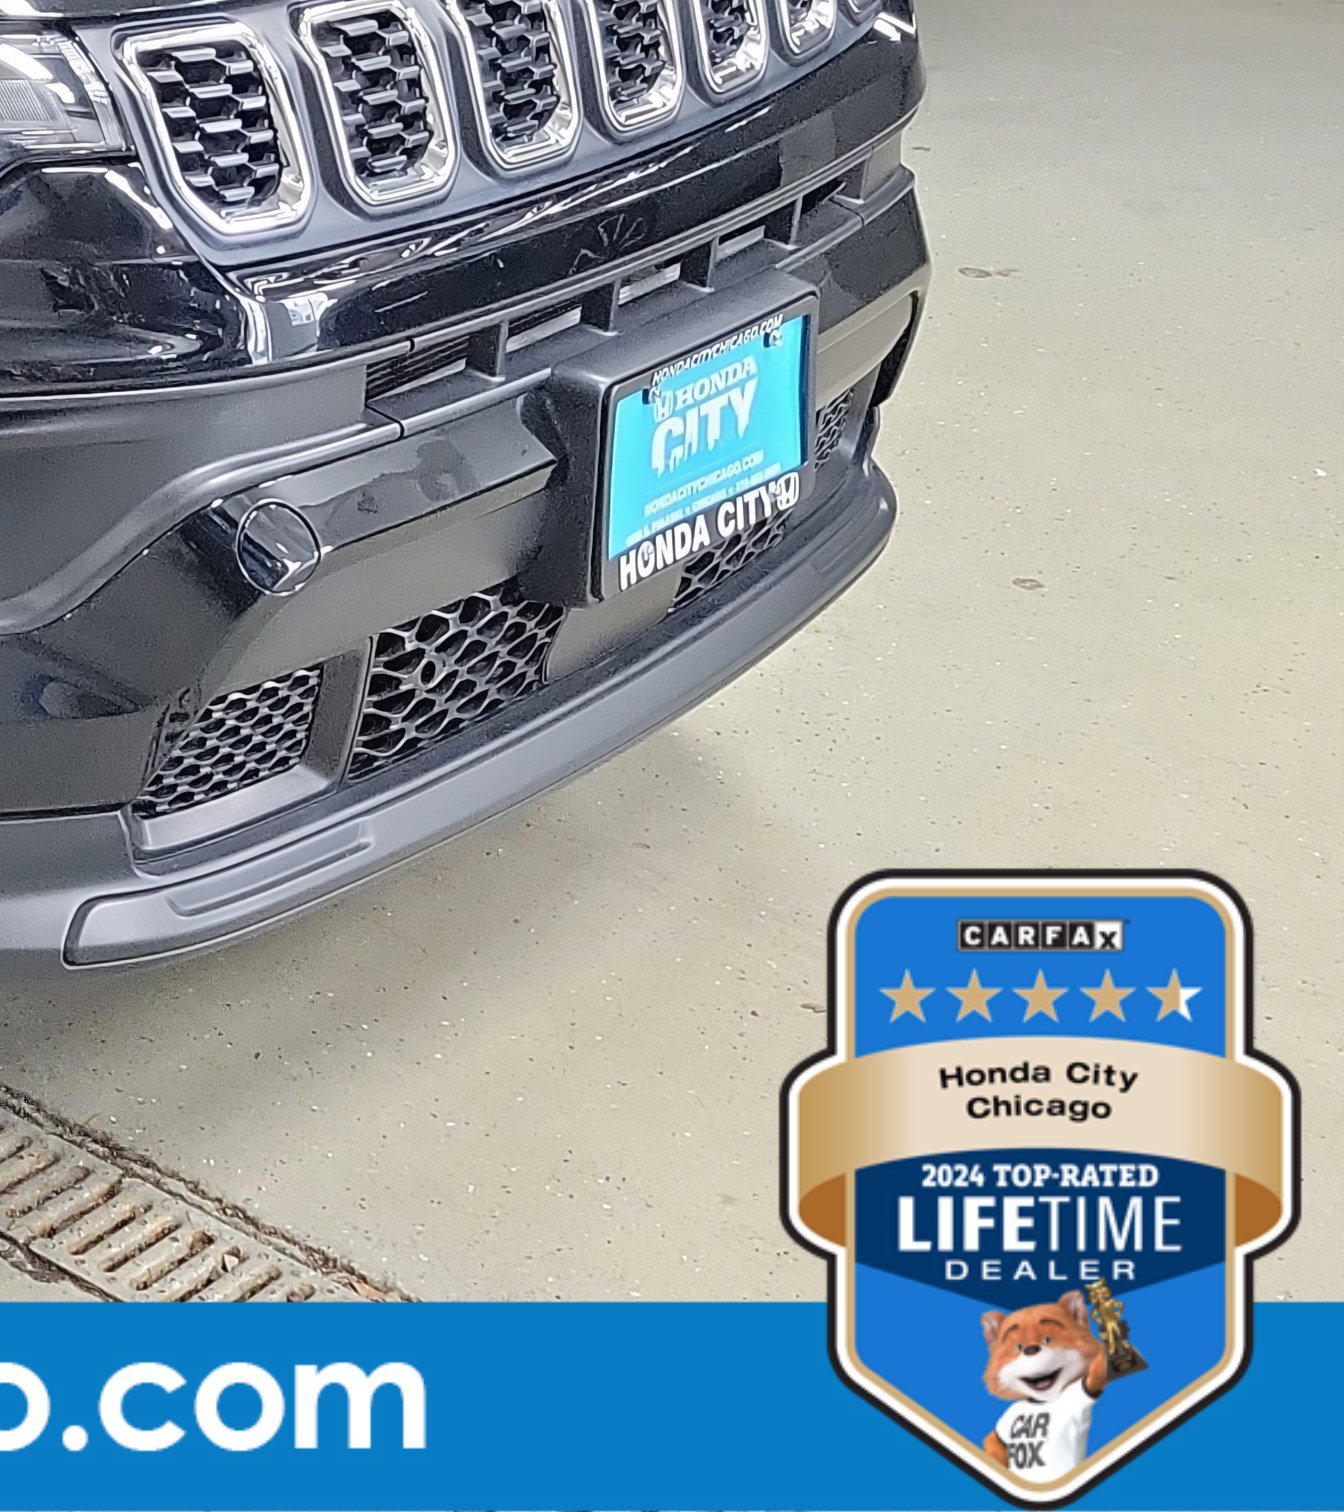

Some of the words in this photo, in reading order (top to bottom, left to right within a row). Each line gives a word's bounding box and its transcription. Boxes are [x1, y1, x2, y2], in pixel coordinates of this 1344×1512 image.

[651, 377, 758, 477] CITY
[675, 355, 758, 410] HONDA
[618, 515, 711, 591] HONDA
[717, 484, 773, 538] CITY
